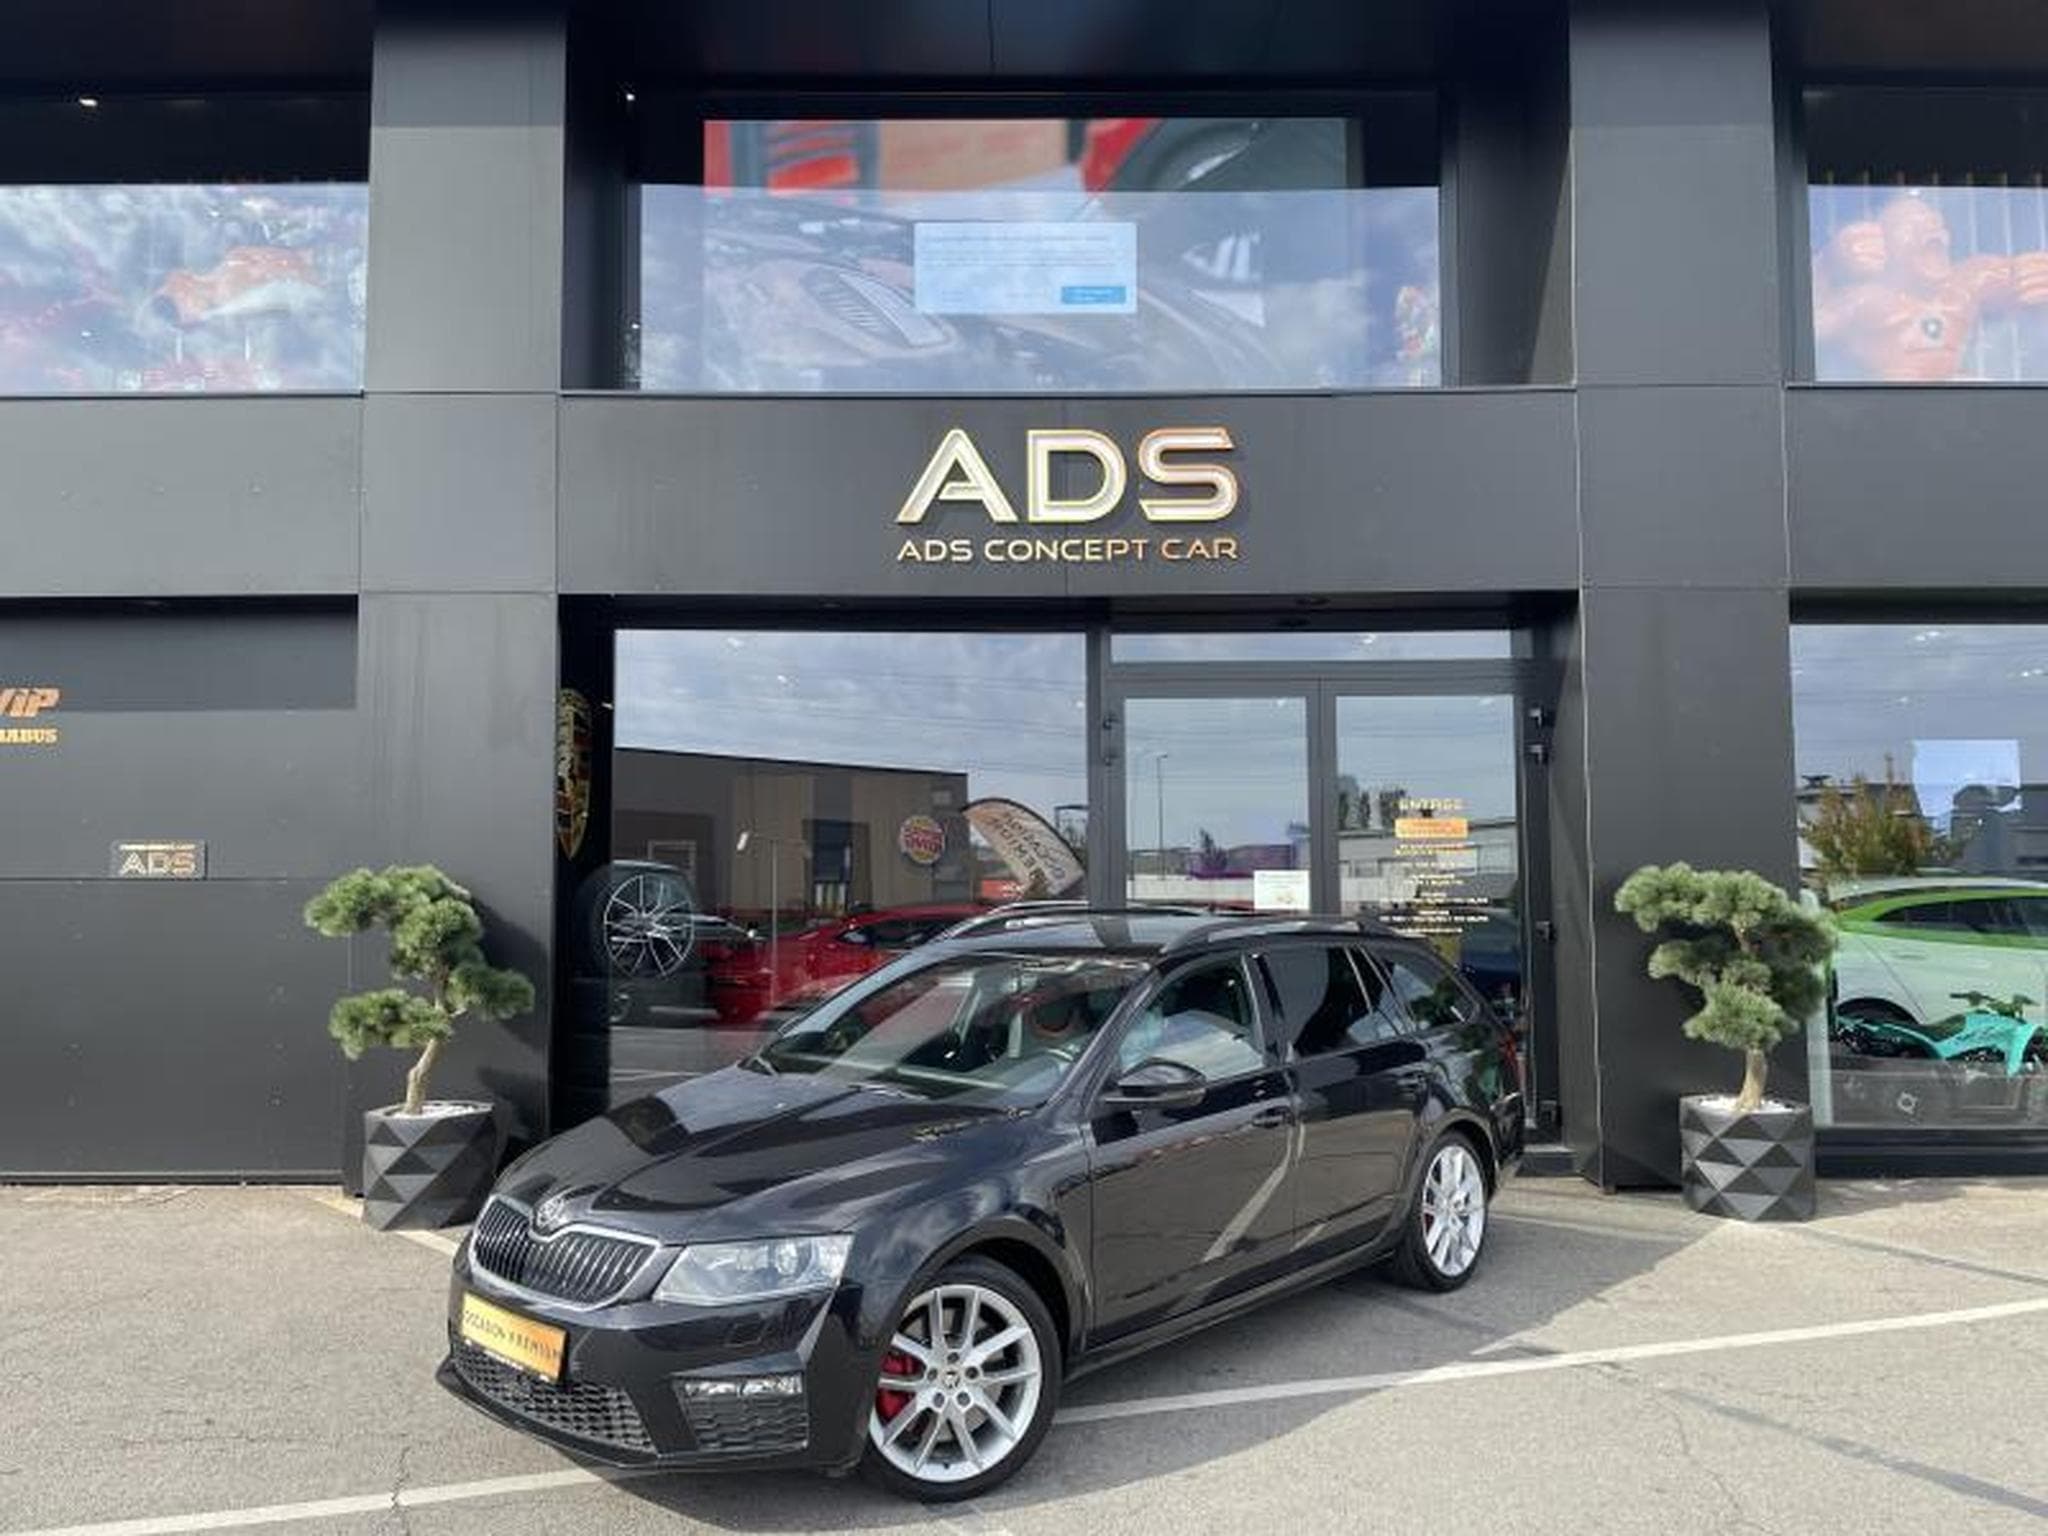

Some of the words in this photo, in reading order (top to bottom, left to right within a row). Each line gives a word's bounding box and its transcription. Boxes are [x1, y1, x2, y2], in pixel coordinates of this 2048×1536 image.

[896, 427, 1239, 523] ADS
[897, 538, 974, 562] ADS
[984, 538, 1150, 562] CONCEPT
[1160, 538, 1238, 561] CAR
[119, 851, 197, 877] ADS
